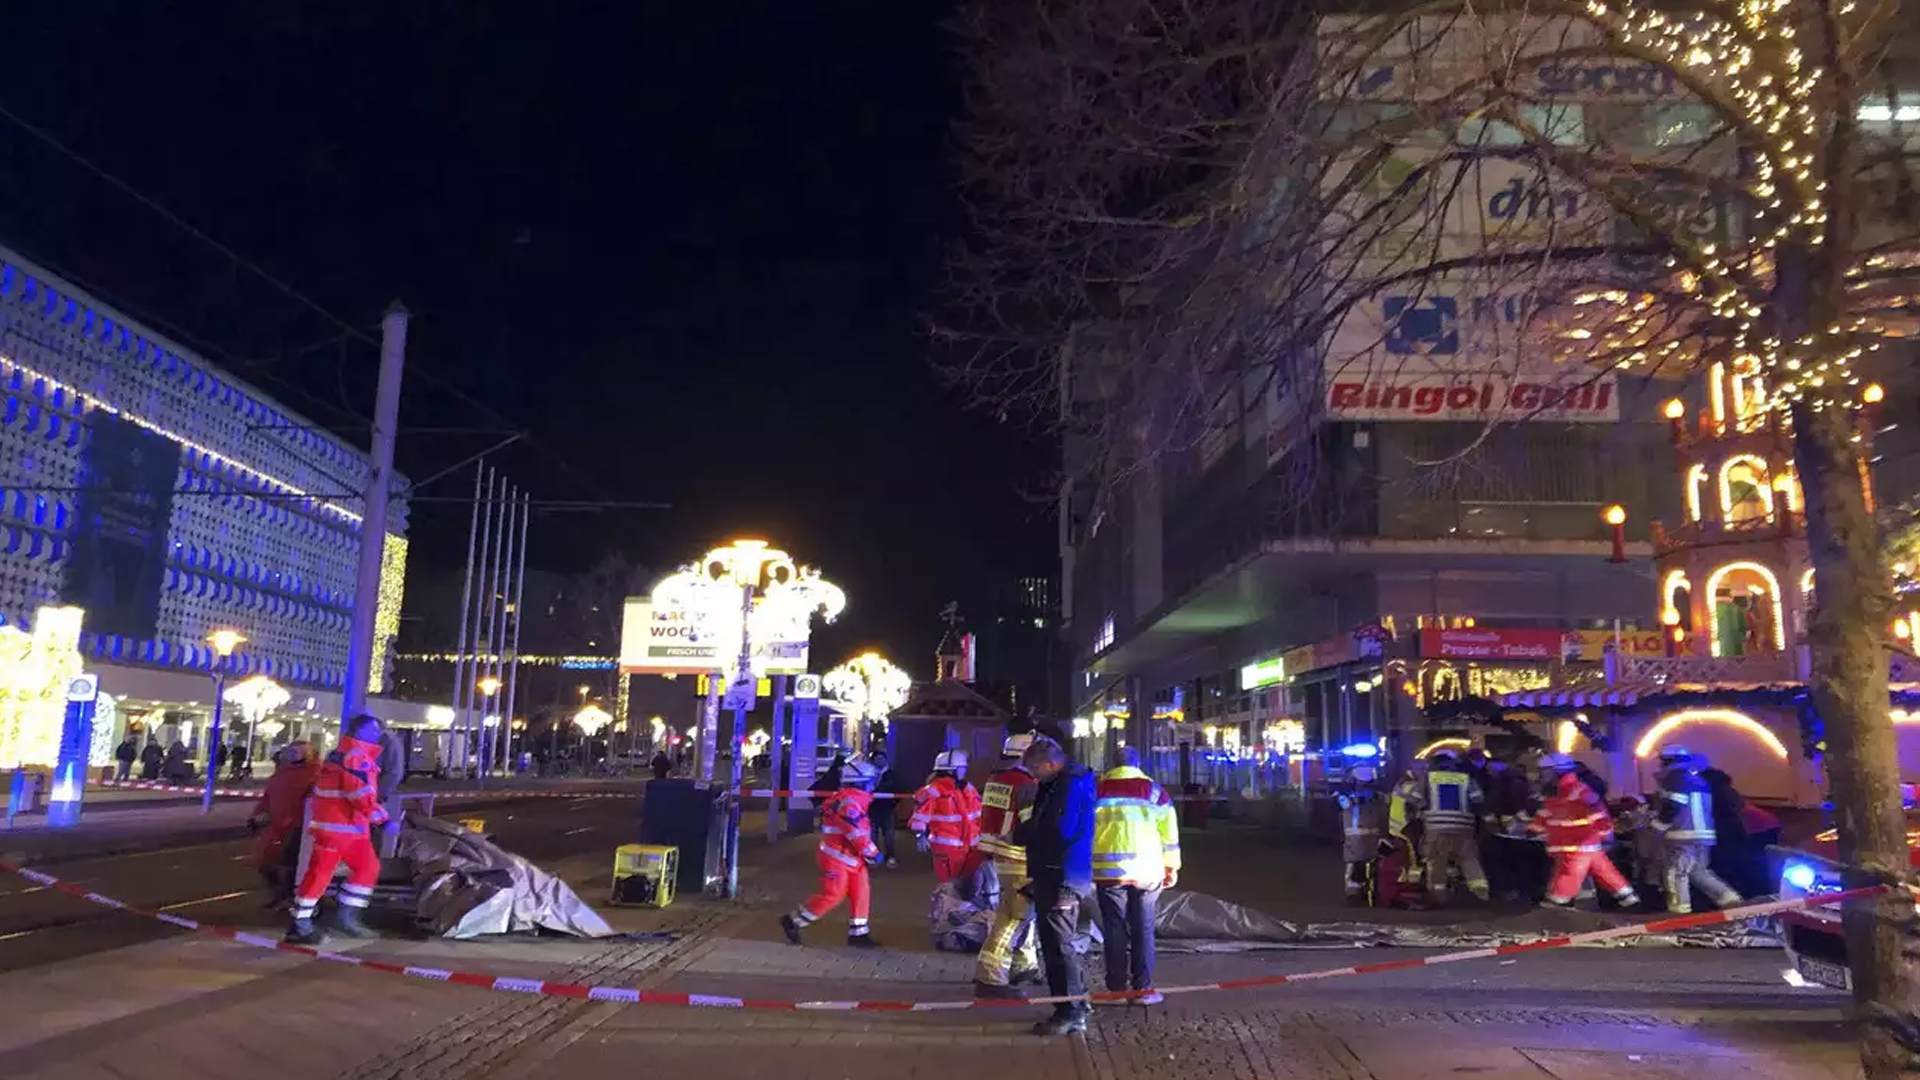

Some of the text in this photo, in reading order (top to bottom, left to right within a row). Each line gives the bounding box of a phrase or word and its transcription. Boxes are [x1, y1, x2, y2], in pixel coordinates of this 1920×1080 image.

[1488, 178, 1580, 219] dm
[1329, 379, 1615, 415] Bingöl Grill
